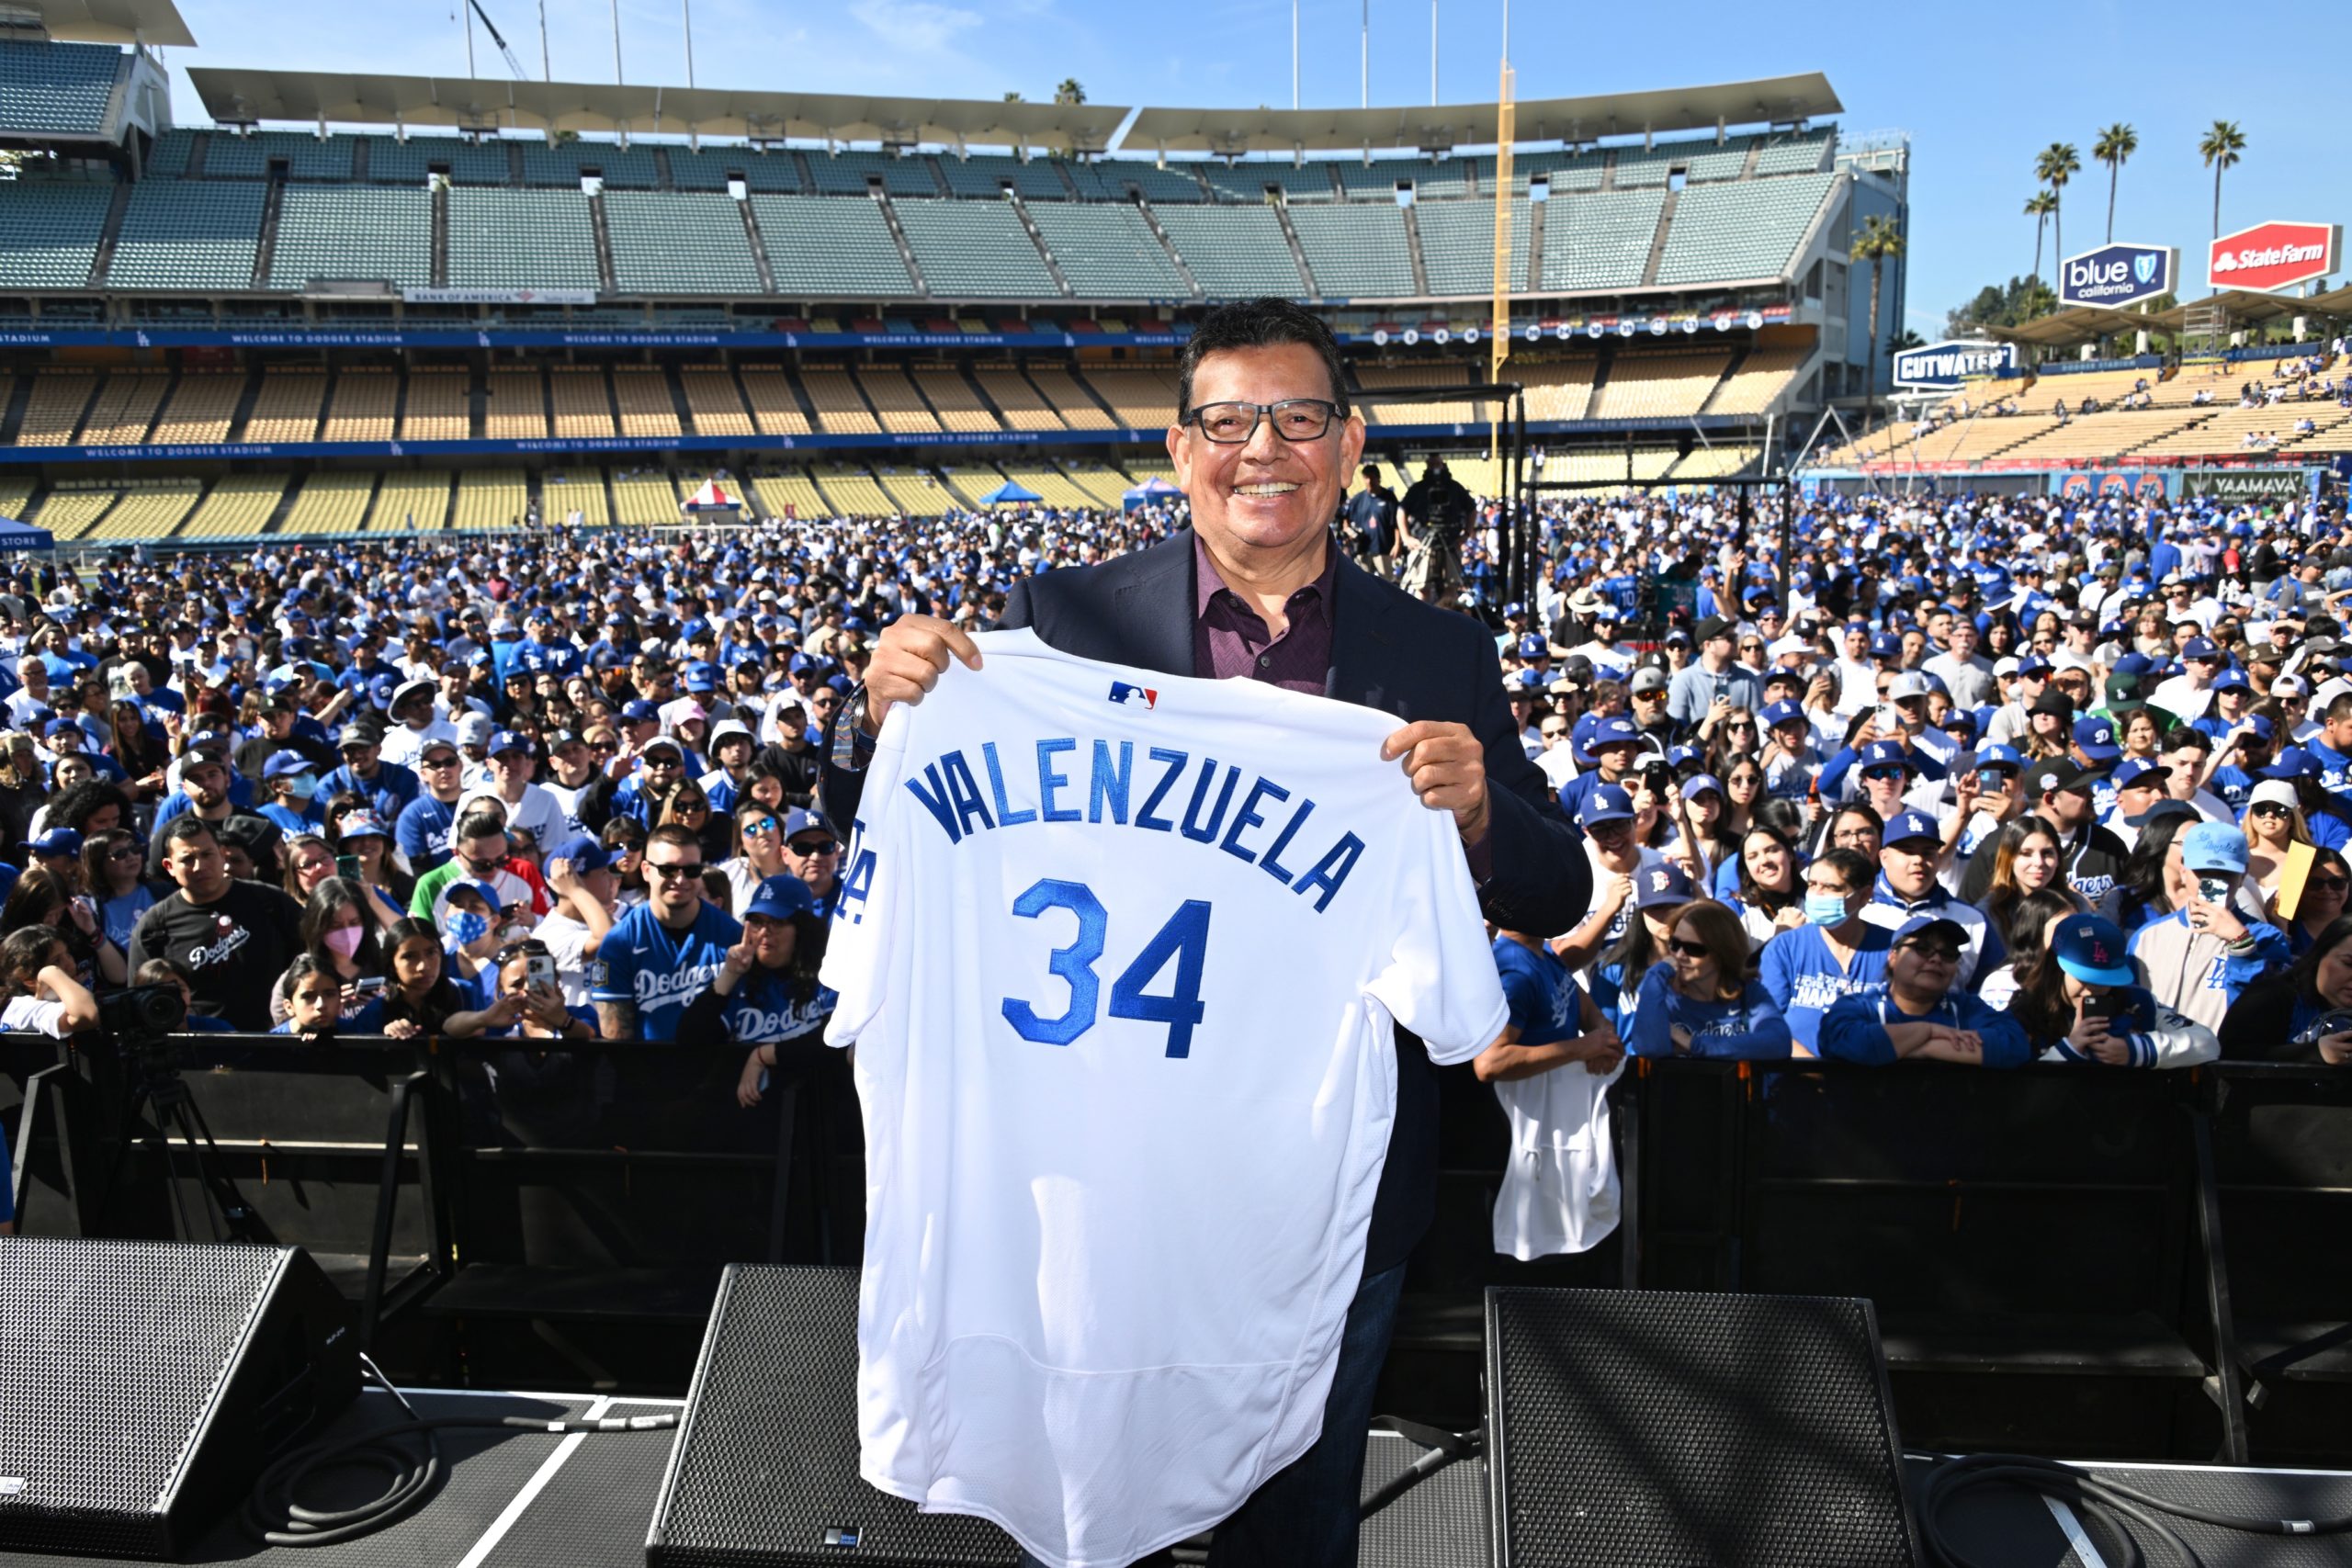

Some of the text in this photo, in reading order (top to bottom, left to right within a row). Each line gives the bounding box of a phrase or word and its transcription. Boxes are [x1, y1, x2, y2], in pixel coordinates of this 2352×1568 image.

[2070, 259, 2129, 287] blue
[415, 293, 513, 301] BANK OF AMERICA
[2077, 283, 2134, 299] california
[85, 448, 142, 457] WELCOME
[167, 446, 216, 456] DODGER
[220, 446, 272, 454] STADIUM
[588, 440, 630, 448] DODGER
[635, 439, 680, 447] STADIUM
[2070, 483, 2087, 497] 76
[2105, 482, 2124, 498] 76
[2142, 482, 2159, 499] 76
[1, 536, 38, 547] STORE
[1594, 793, 1609, 810] LA
[805, 811, 820, 826] LA
[904, 738, 1366, 914] VALENZUELA
[1907, 815, 1924, 832] LA
[189, 925, 250, 970] Dodgers
[2094, 941, 2109, 963] LA
[1001, 878, 1212, 1059] 34
